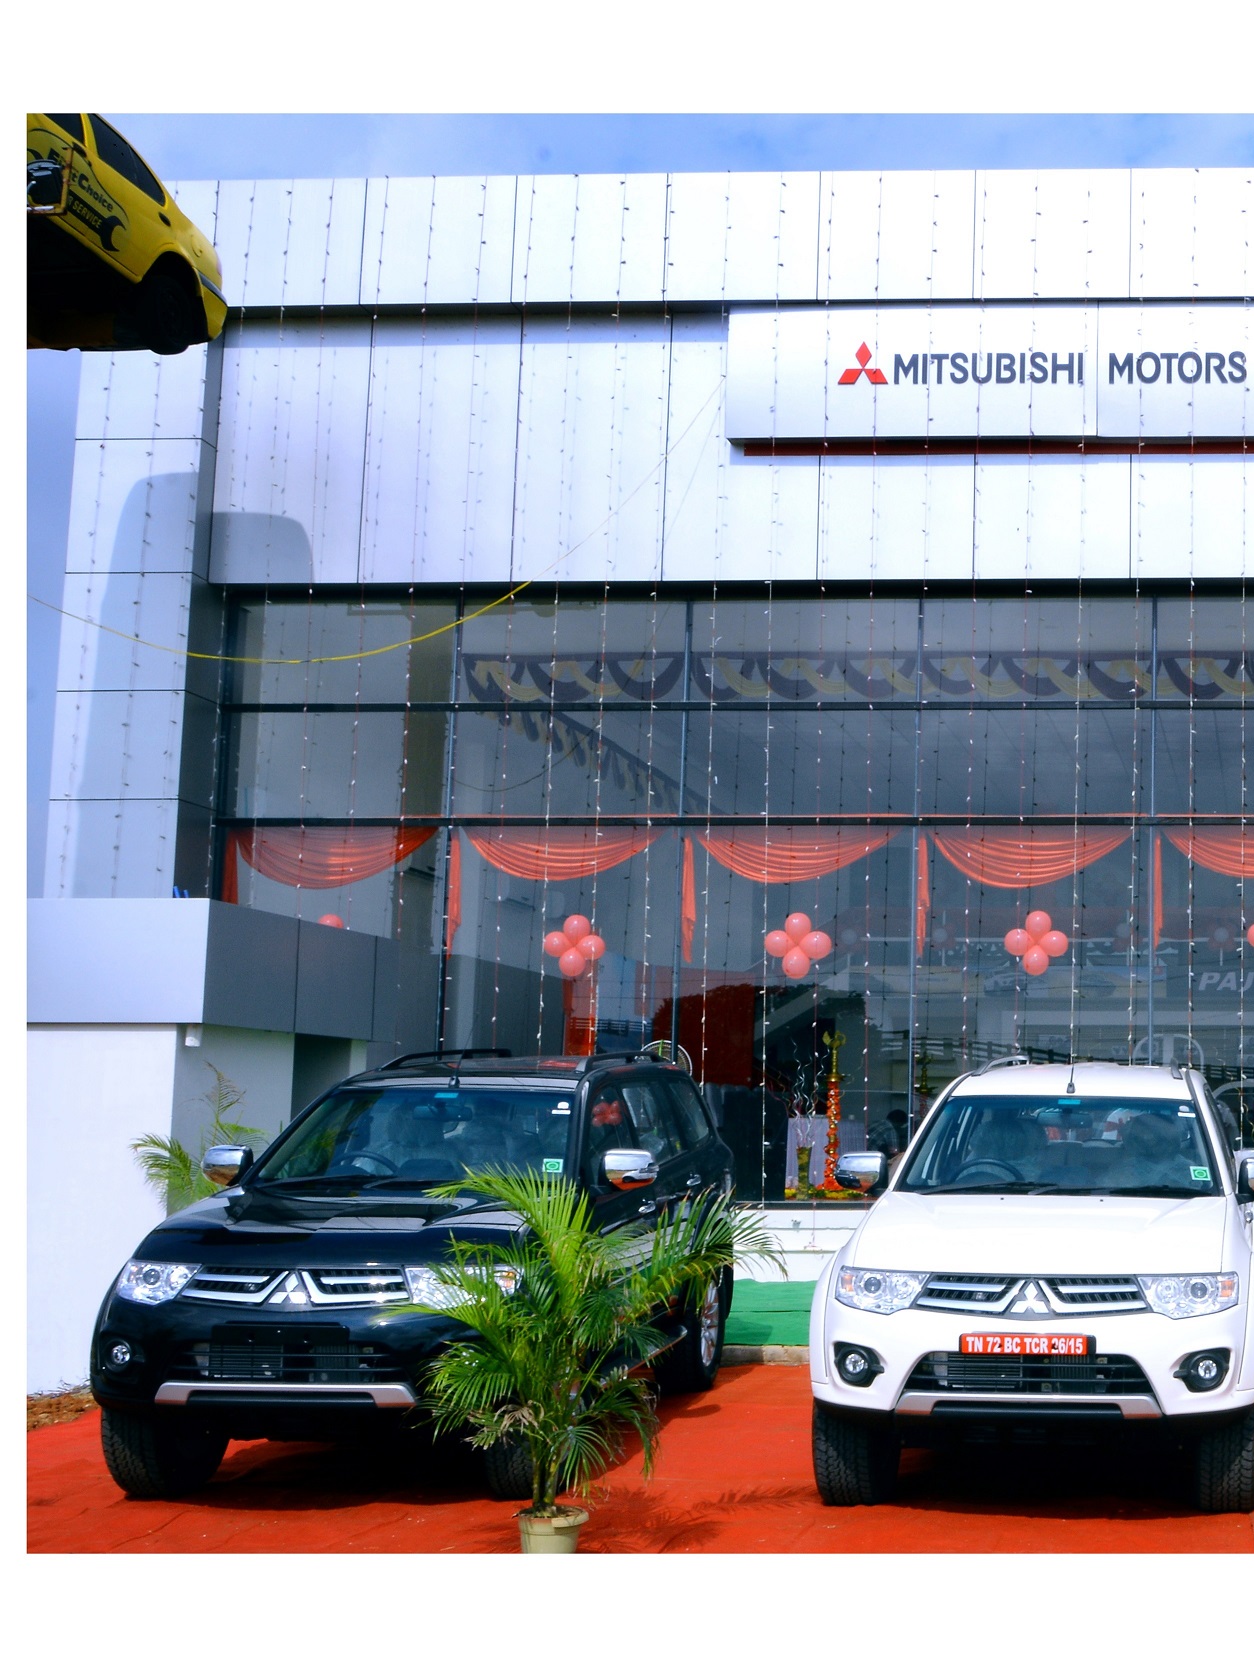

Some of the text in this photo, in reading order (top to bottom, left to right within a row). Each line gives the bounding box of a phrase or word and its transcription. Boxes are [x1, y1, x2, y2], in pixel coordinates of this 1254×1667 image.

[78, 173, 114, 212] Choice
[72, 200, 103, 228] SERVICE
[892, 351, 1248, 386] MITSUBISHI MOTORS
[966, 1336, 1084, 1354] TN 72 BC TCR 26/15
